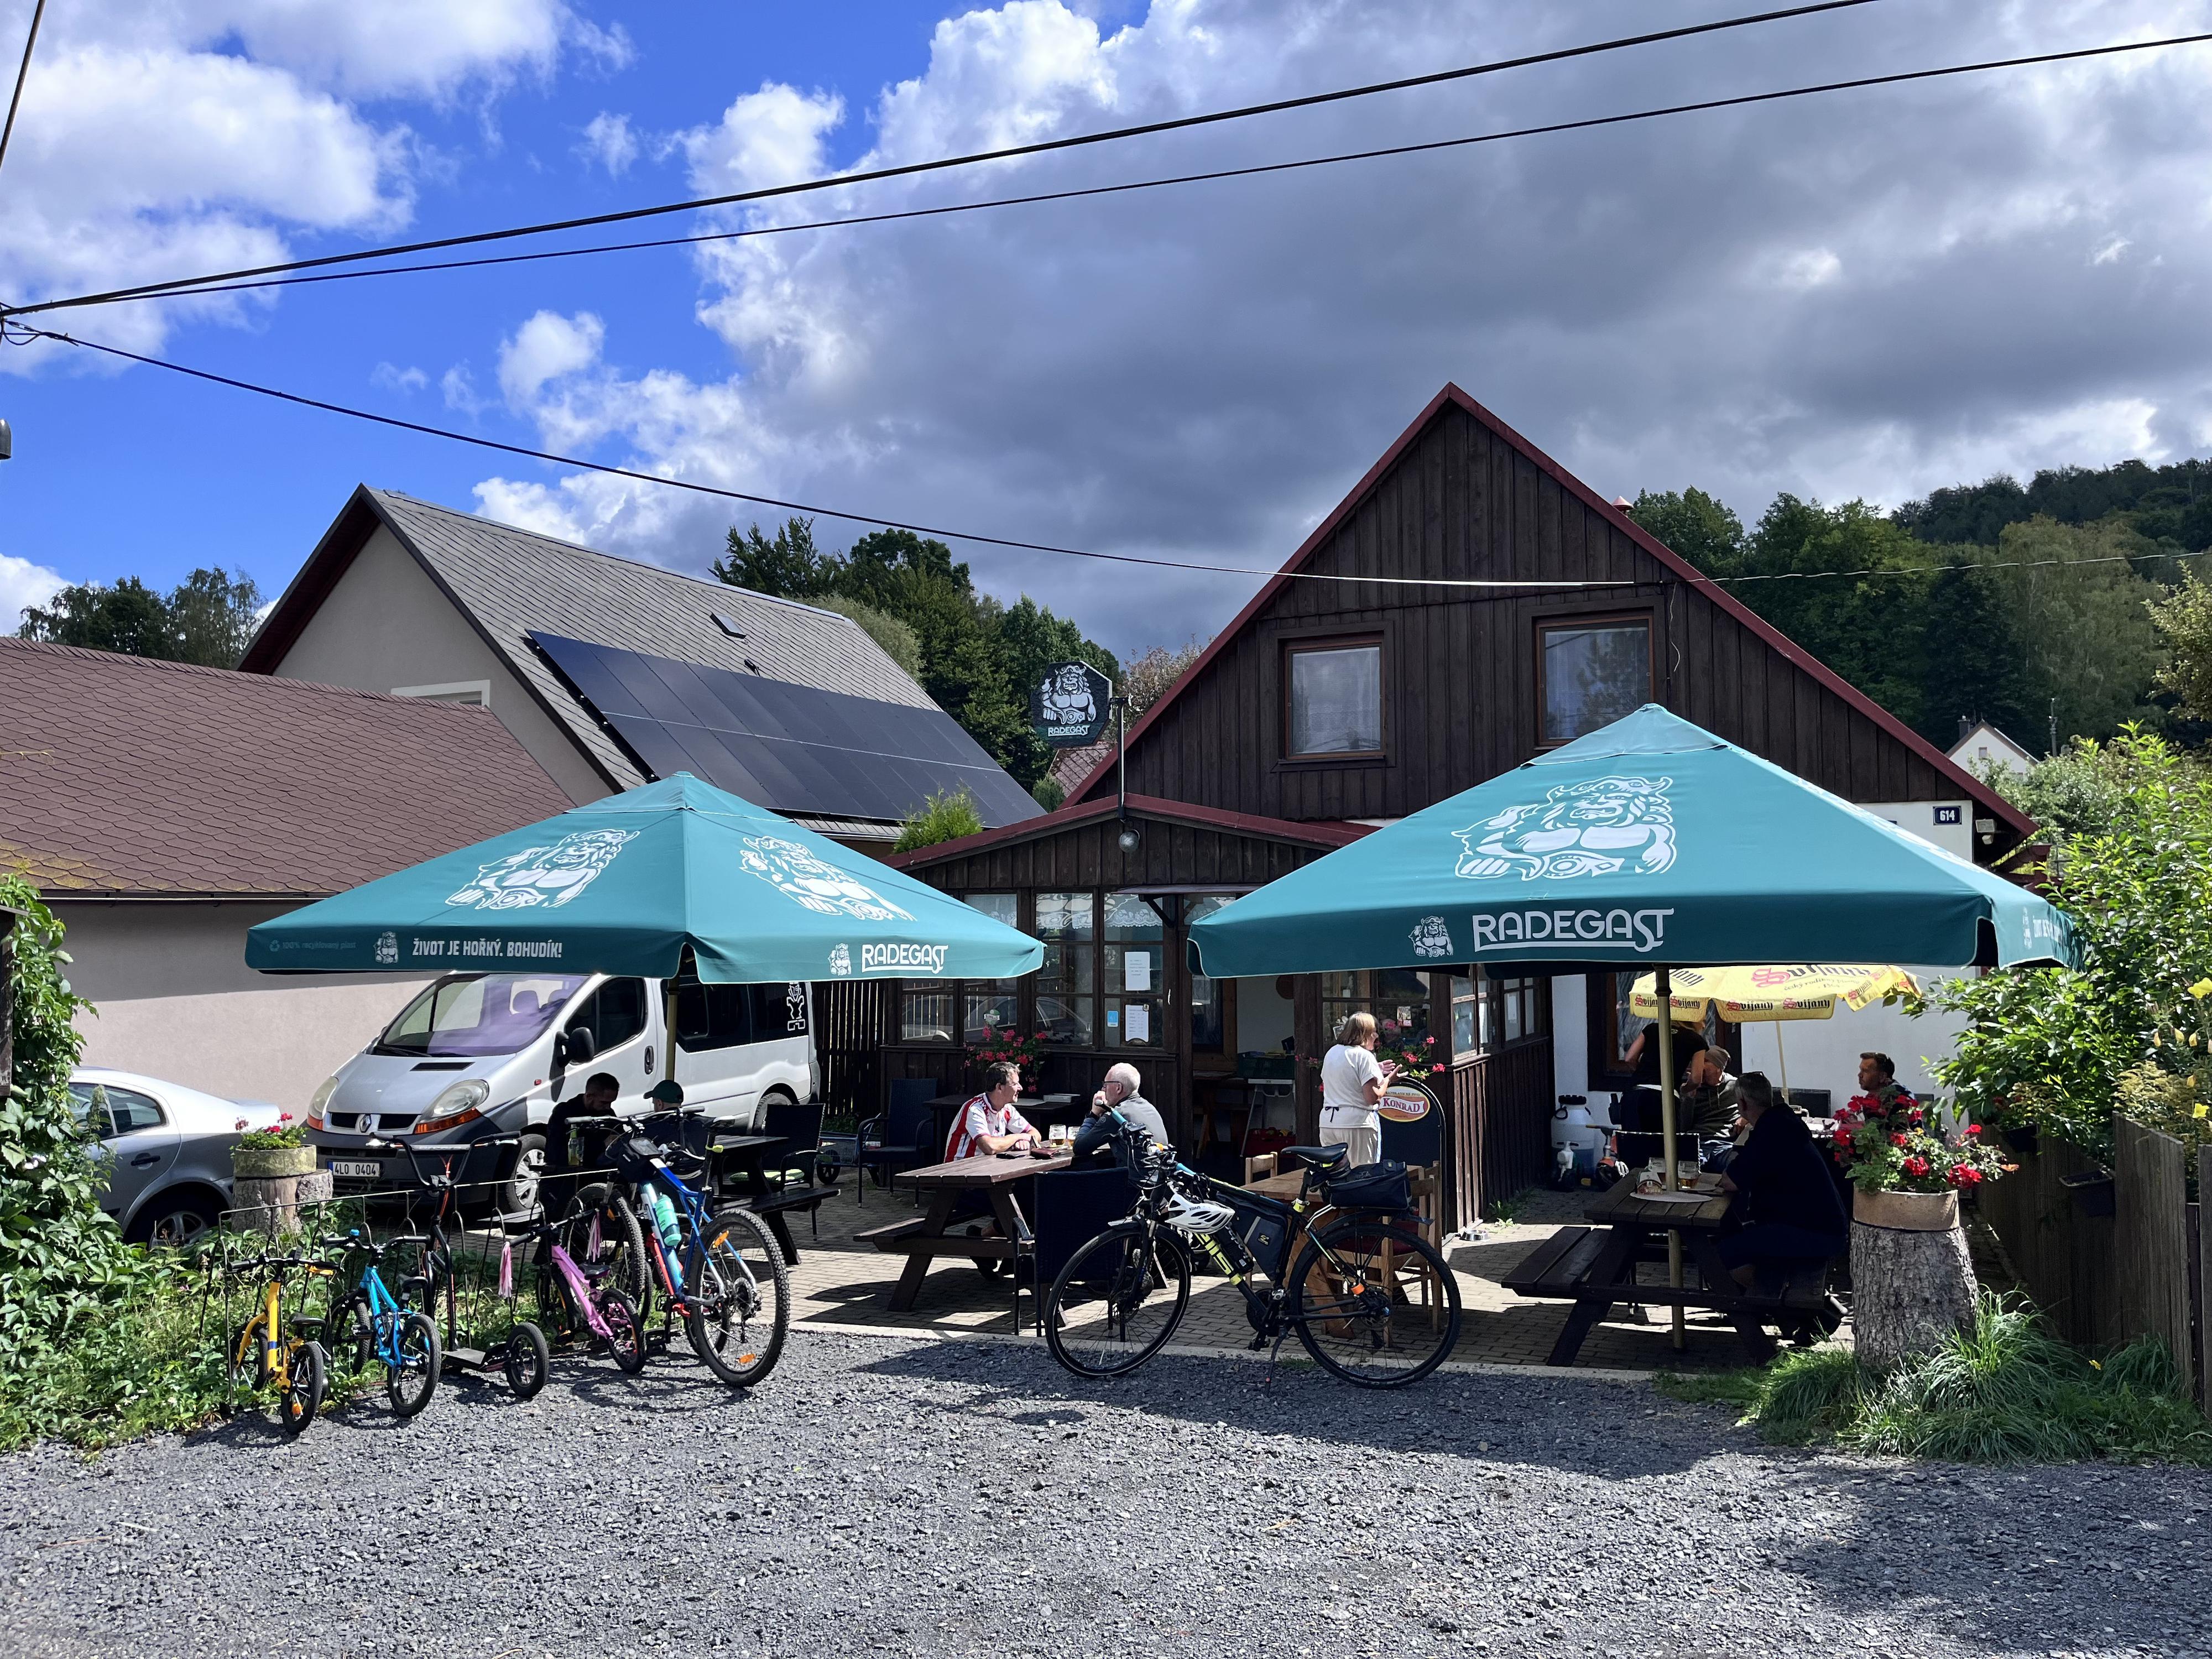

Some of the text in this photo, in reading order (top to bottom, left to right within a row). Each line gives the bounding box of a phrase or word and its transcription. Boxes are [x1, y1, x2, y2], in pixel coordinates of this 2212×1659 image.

[1048, 725, 1090, 737] RADEGAST
[1940, 810, 1955, 821] 614
[1473, 908, 1674, 952] RADEGAST
[412, 938, 562, 958] ŽIVOT JE HOŘKÝ. BOHUDÍK!
[862, 943, 948, 974] RADEGAST
[1782, 998, 1830, 1010] Svijany
[1383, 1098, 1420, 1113] KONRAD
[355, 1164, 376, 1176] 0404
